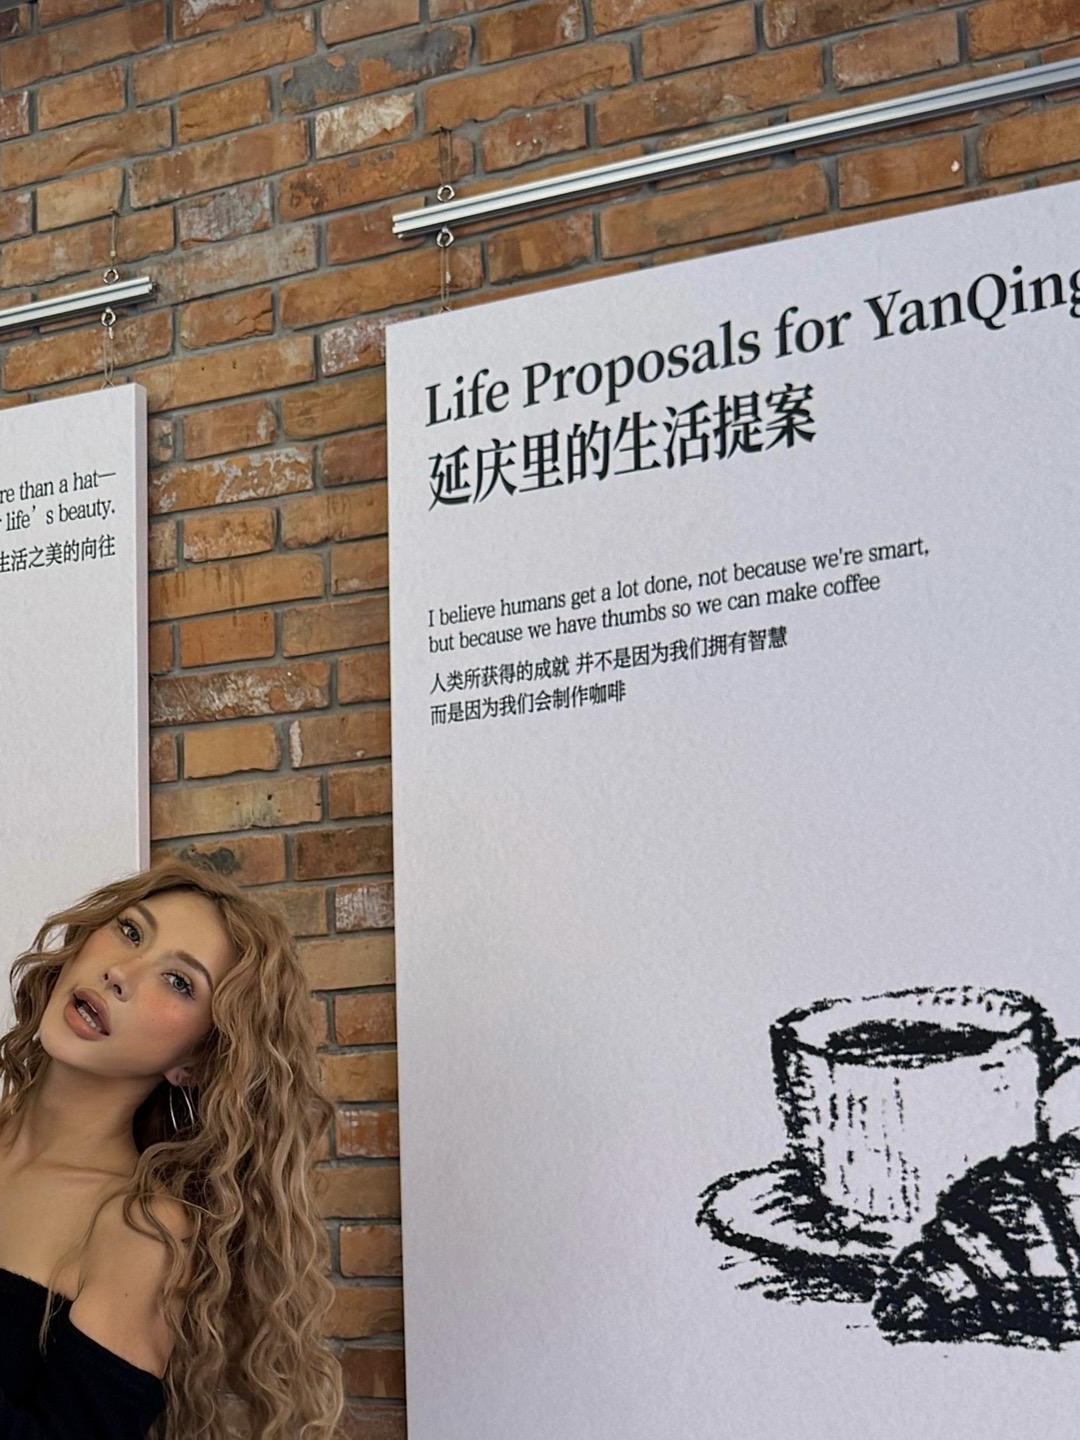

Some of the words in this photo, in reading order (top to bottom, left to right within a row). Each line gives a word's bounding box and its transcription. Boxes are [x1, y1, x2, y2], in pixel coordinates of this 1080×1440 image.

[425, 368, 509, 427] Life
[522, 320, 760, 408] Proposals
[774, 306, 852, 358] for
[428, 383, 816, 511] 延庆里的生活提案
[19, 480, 54, 501] than
[59, 478, 68, 494] a
[58, 498, 115, 522] beauty.
[429, 609, 434, 627] I
[439, 604, 496, 625] believe
[500, 594, 566, 617] humans
[571, 586, 596, 610] get
[601, 587, 611, 601] a
[617, 579, 639, 599] lot
[644, 575, 692, 595] done,
[698, 566, 728, 587] not
[733, 558, 806, 581] because
[812, 547, 863, 570] we're
[869, 537, 929, 562] smart,
[429, 634, 455, 653] but
[459, 627, 523, 649] because
[527, 623, 551, 639] we
[556, 616, 596, 635] have
[602, 603, 667, 628] thumbs
[672, 602, 691, 618] so
[696, 598, 722, 615] we
[727, 592, 760, 610] can
[766, 581, 817, 605] make
[823, 573, 880, 597] coffee
[430, 655, 570, 695] 人类所获得的成就
[575, 625, 787, 675] 并不是因为我们拥有智慧
[430, 680, 626, 726] 而是因为我们会制作咖啡
